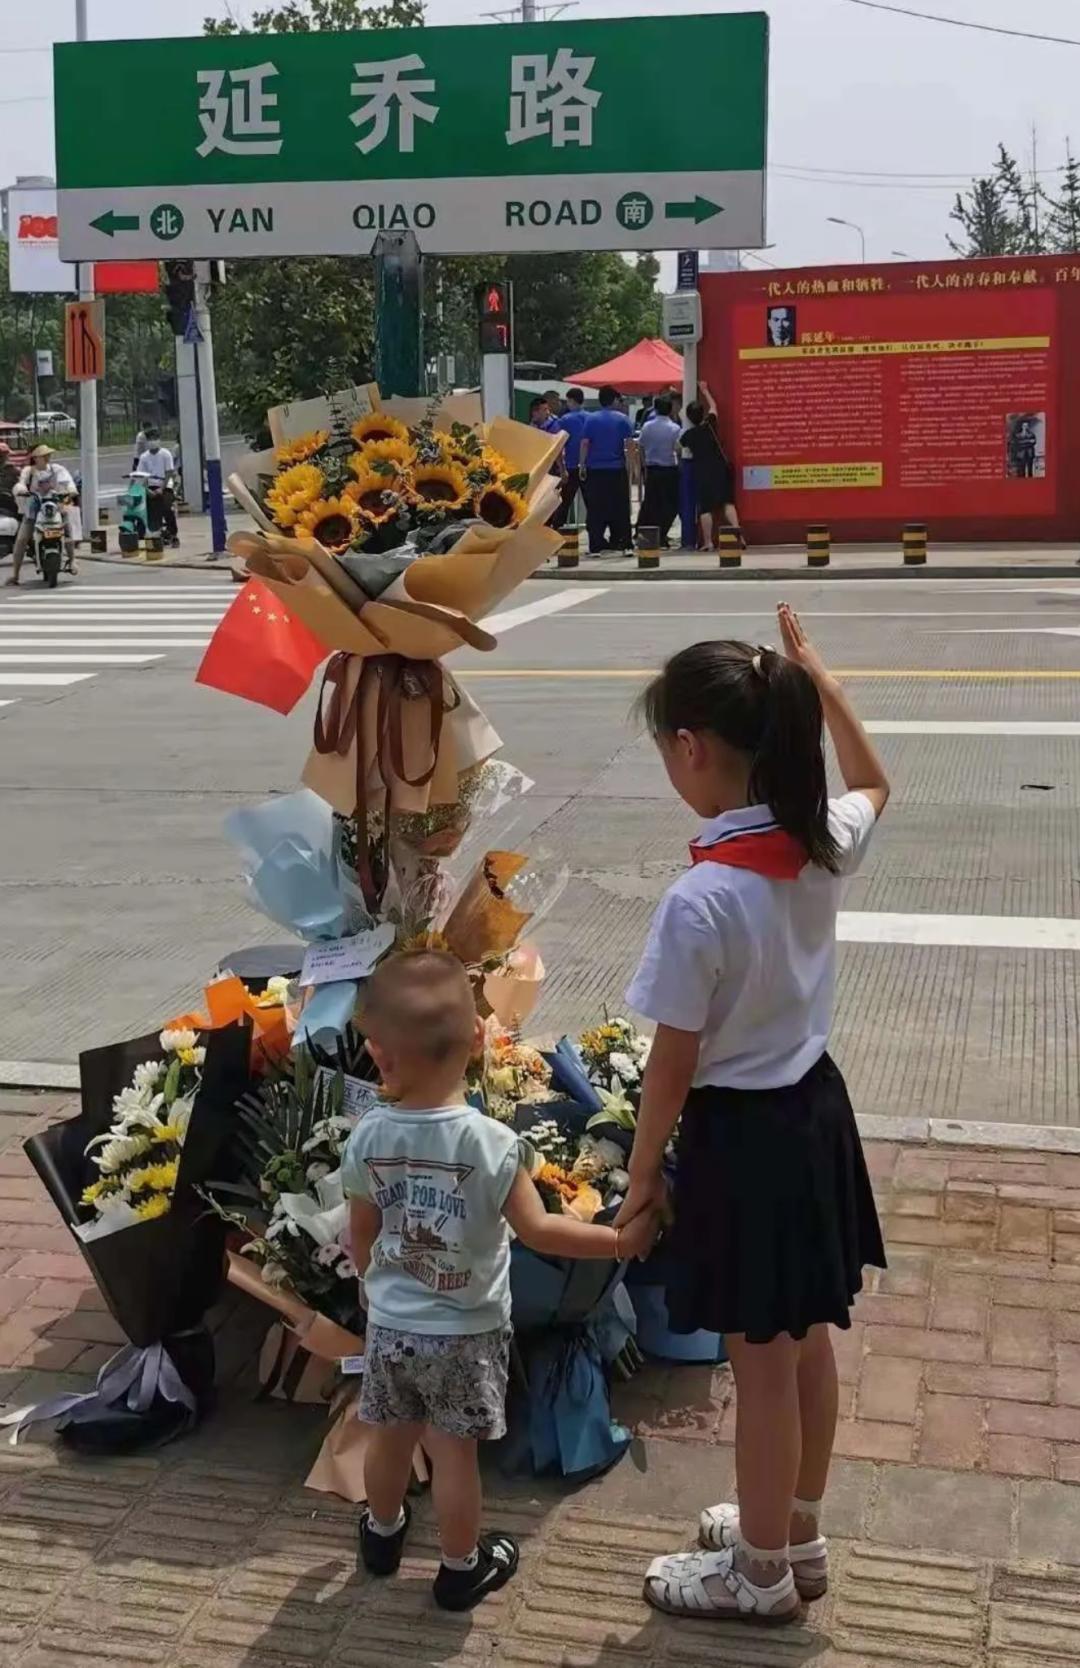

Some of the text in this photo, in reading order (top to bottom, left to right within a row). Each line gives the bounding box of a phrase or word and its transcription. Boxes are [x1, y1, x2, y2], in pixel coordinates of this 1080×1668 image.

[194, 48, 603, 158] 延乔路
[157, 198, 646, 235] 北 YAN QIAO ROAD 南
[410, 1184, 438, 1209] FOR
[438, 1189, 468, 1220] LOVE
